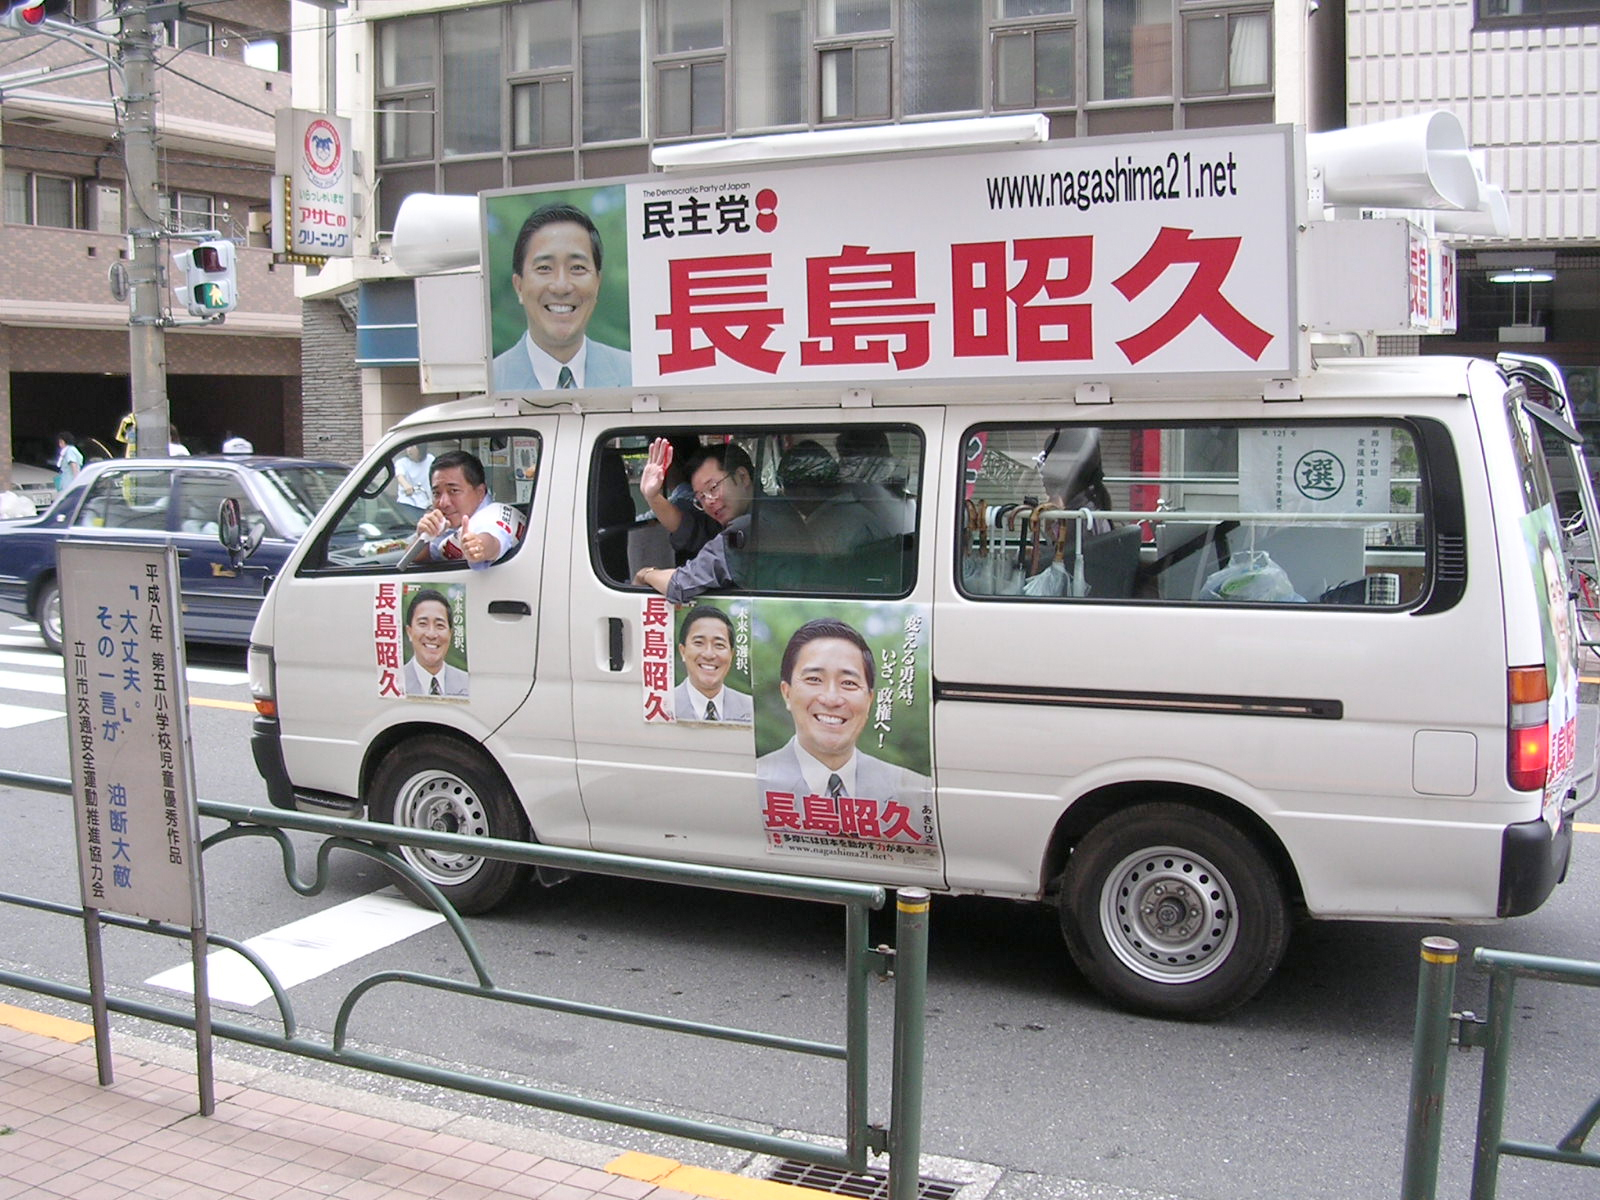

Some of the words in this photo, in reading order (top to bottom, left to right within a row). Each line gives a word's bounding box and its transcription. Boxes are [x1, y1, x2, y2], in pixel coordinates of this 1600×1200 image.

[642, 189, 655, 197] The
[656, 185, 698, 197] Democratic
[700, 183, 717, 194] Party
[719, 183, 727, 191] of
[727, 182, 750, 192] Japan
[986, 151, 1237, 211] www.nagashima21.net
[298, 230, 348, 247] クリーニング
[299, 207, 346, 227] アサヒの
[642, 194, 750, 240] 民主党
[655, 226, 1276, 376] 長島昭久
[1299, 457, 1338, 493] 選
[145, 563, 163, 643] 平成八年
[96, 606, 121, 742] その一言が
[374, 583, 402, 698] 長島昭久
[642, 597, 671, 722] 長島昭久
[897, 614, 922, 706] 変える勇気。
[74, 640, 105, 900] 立川市交通安全運動推進協力会
[151, 652, 182, 865] 第五小学校児童優秀作品
[107, 783, 132, 889] 油断大敵
[762, 790, 923, 842] 長島昭久
[921, 804, 934, 843] あきひさ
[788, 845, 887, 860] www.nagashima21.net
